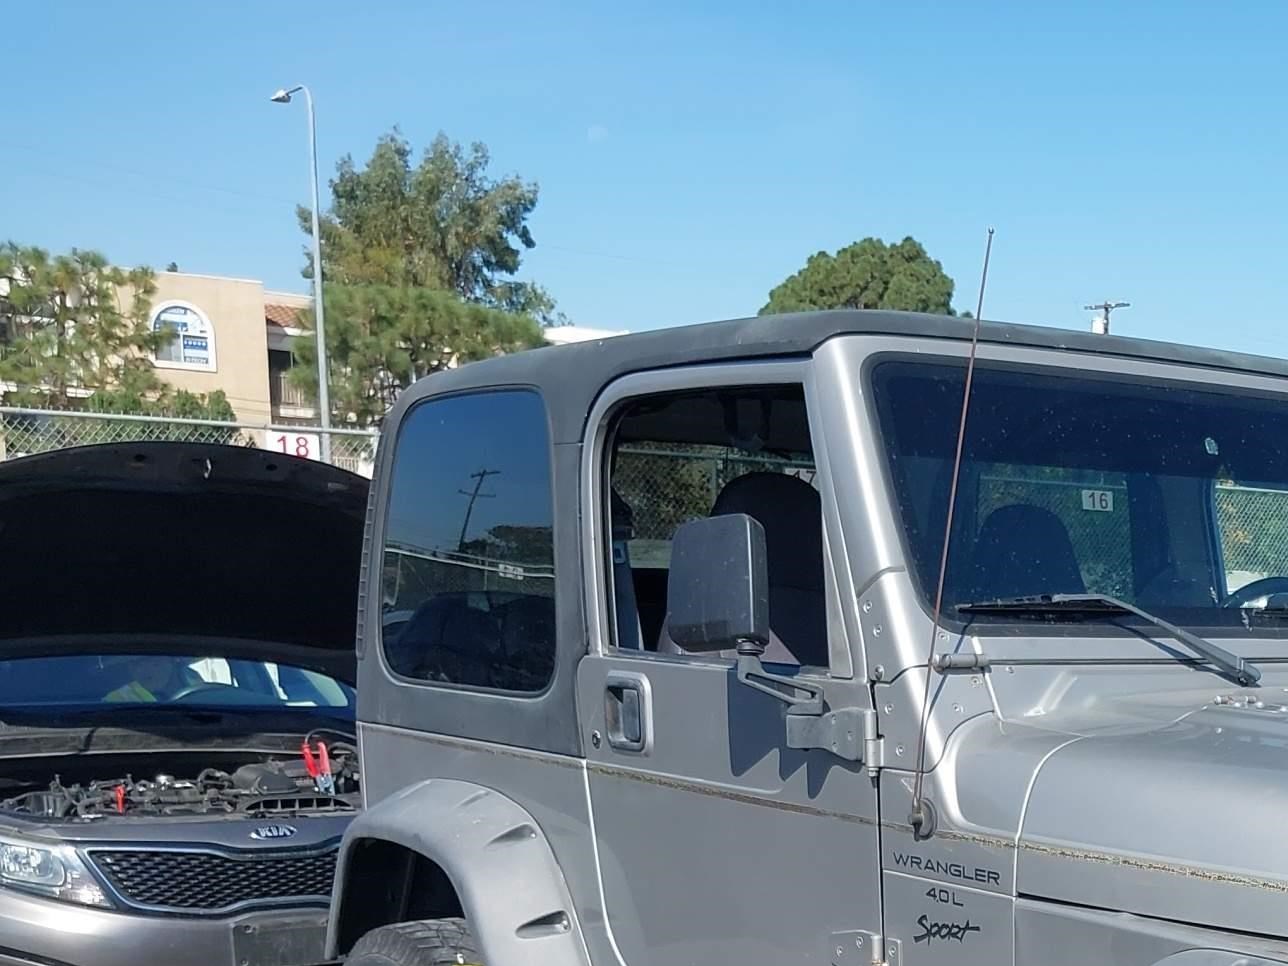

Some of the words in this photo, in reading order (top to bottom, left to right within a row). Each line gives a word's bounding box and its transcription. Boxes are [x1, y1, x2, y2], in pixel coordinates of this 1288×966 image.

[277, 435, 309, 459] 18
[1088, 491, 1109, 510] 16
[257, 825, 292, 838] KIA
[893, 852, 1001, 886] WRANGLER
